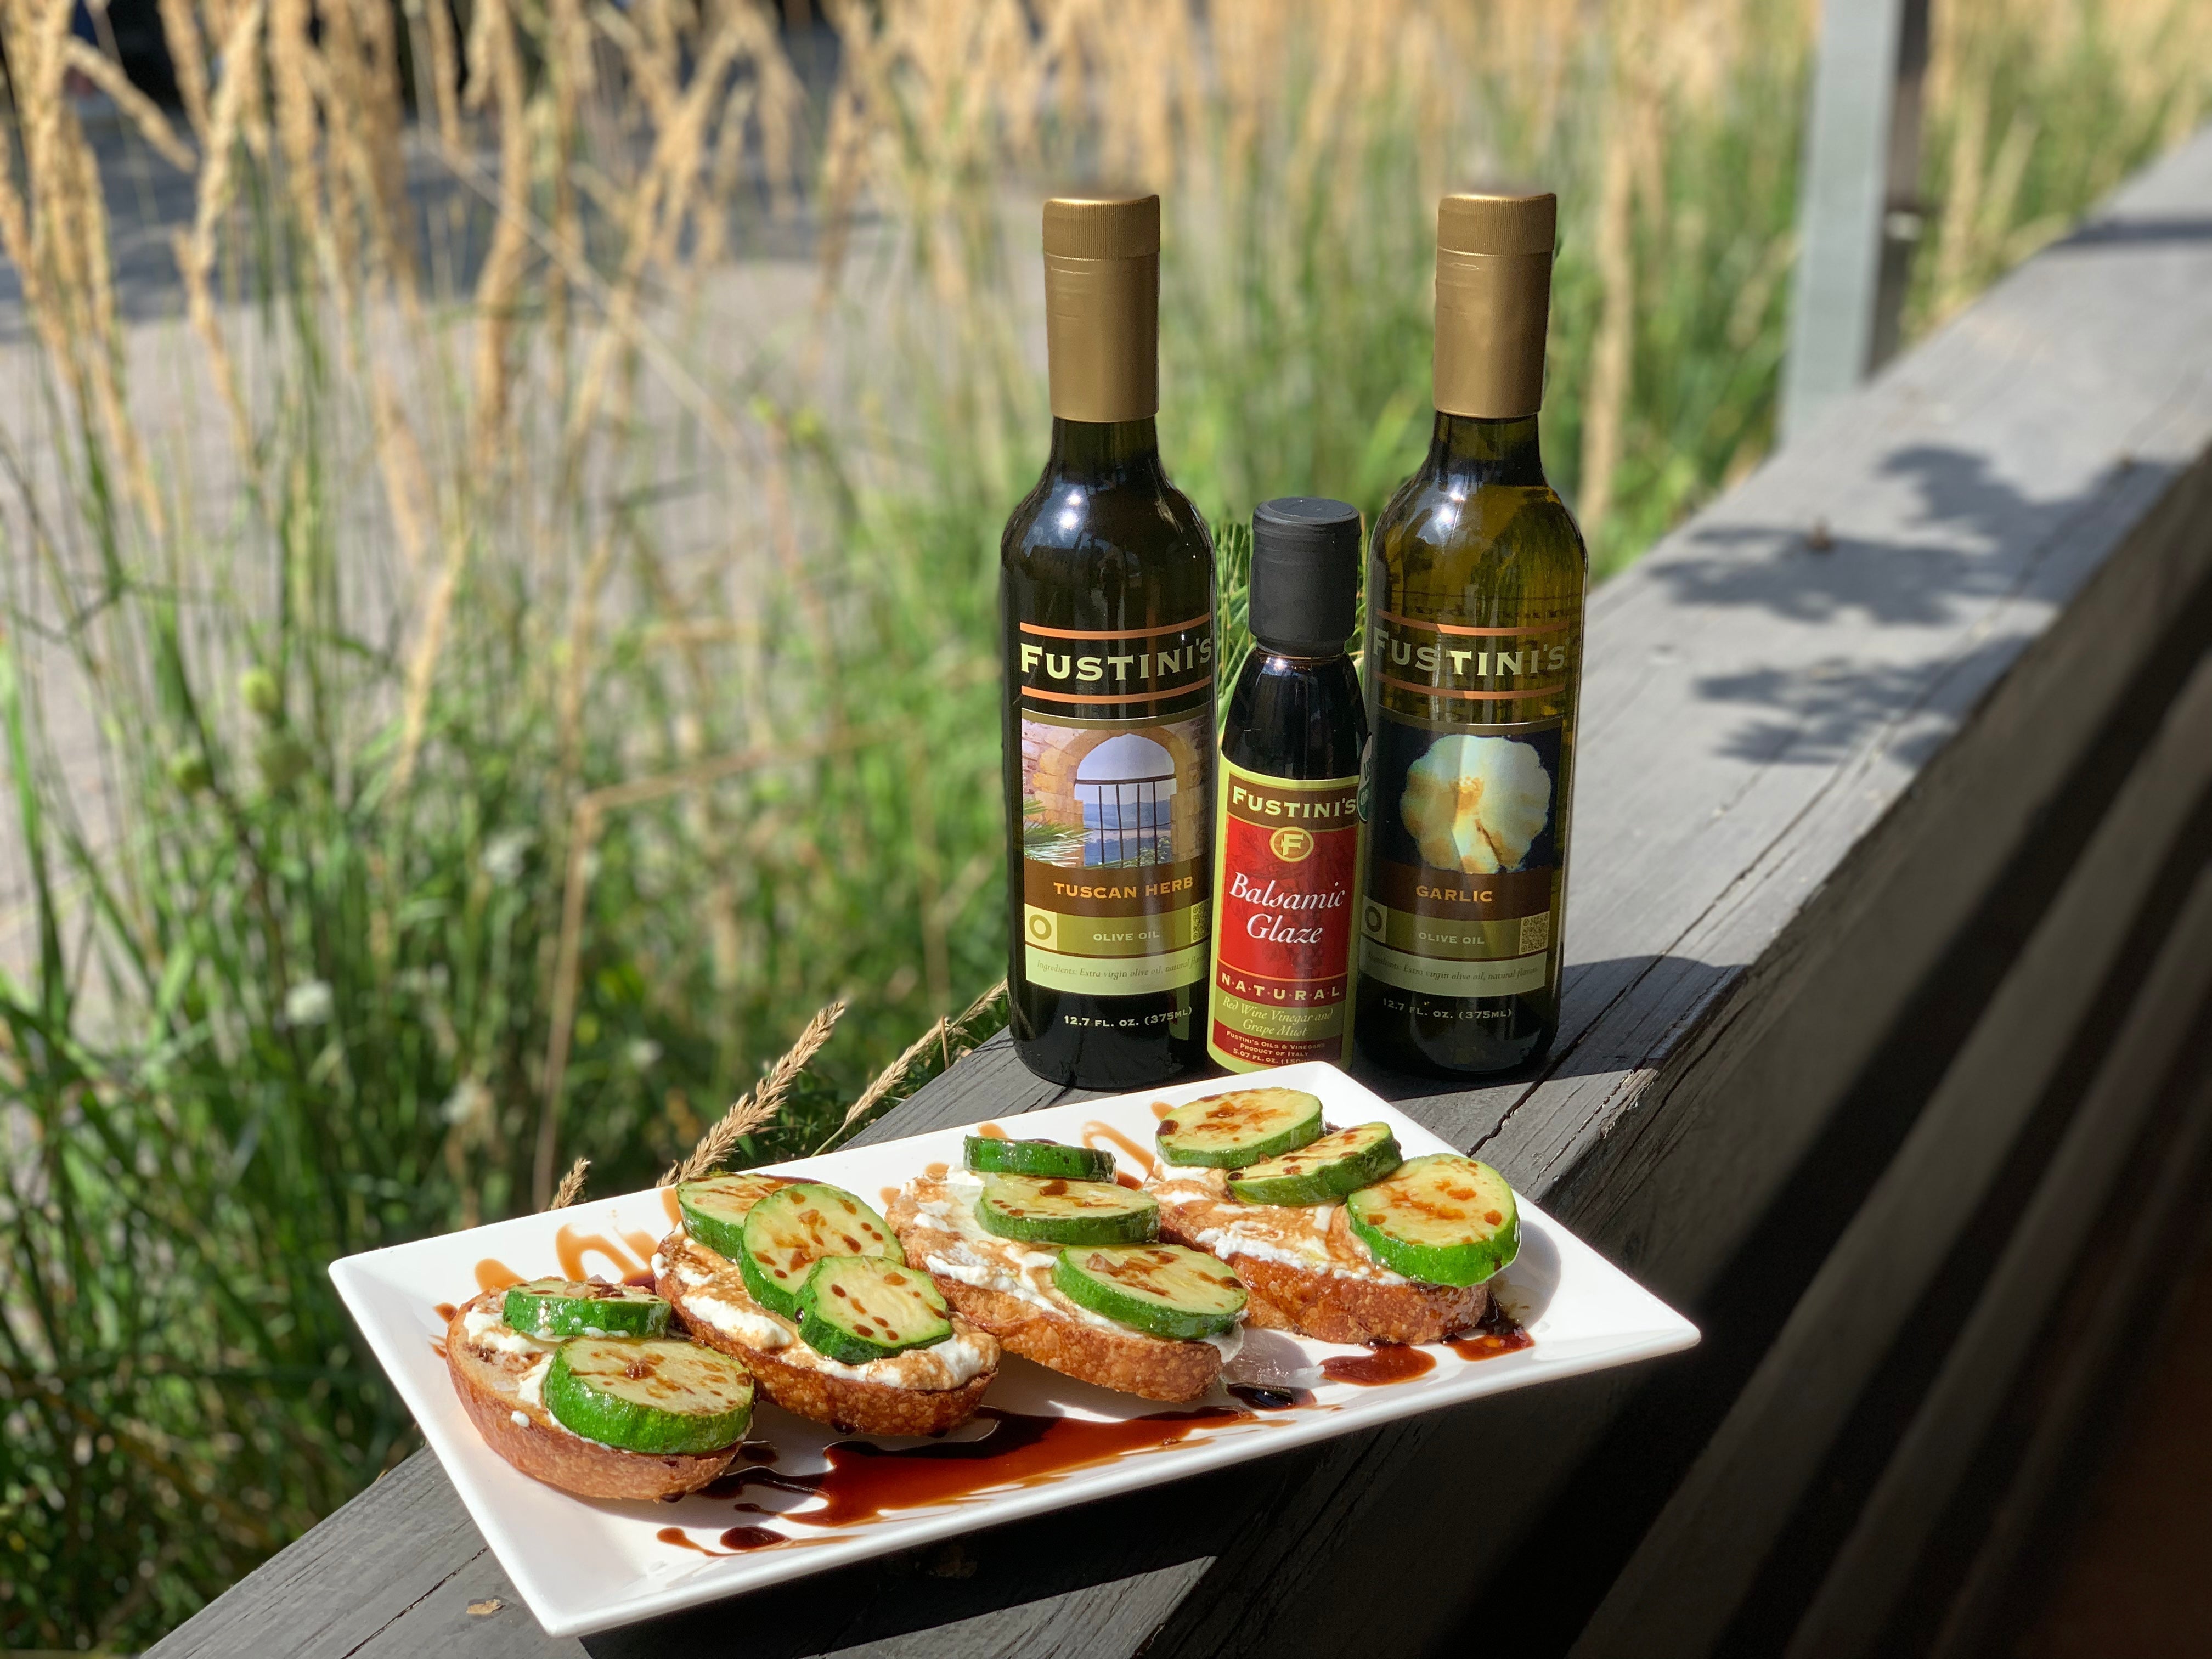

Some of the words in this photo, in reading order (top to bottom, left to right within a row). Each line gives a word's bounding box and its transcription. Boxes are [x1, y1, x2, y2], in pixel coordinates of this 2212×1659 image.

[1020, 638, 1212, 681] FUSTINI'S
[1373, 627, 1565, 676] FUSTINI'S
[1232, 785, 1356, 818] FUSTINI'S
[1280, 833, 1304, 856] F
[1053, 882, 1137, 899] TUSCAN
[1146, 876, 1193, 896] HERB
[1229, 872, 1345, 910] Balsamic
[1416, 885, 1493, 902] GARLIC
[1093, 933, 1133, 941] OLIVE
[1138, 930, 1160, 940] OIL
[1246, 913, 1324, 944] Glaze
[1419, 932, 1457, 944] OLIVE
[1462, 936, 1485, 945] OIL
[1037, 960, 1077, 975] Ingredients:
[1080, 968, 1101, 977] Extra
[1104, 972, 1127, 980] virgin
[1130, 968, 1149, 977] olive
[1151, 966, 1163, 974] oil,
[1165, 958, 1189, 972] natural
[1403, 964, 1423, 975] Extra
[1426, 971, 1449, 980] virgin
[1452, 972, 1470, 980] olive
[1472, 972, 1486, 980] oil,
[1488, 969, 1515, 980] natural
[1064, 1015, 1090, 1026] 12.7
[1119, 1018, 1139, 1027] OZ.
[1144, 1006, 1192, 1026] (375ML)
[1223, 996, 1239, 1010] Red
[1242, 1003, 1268, 1019] Wine
[1271, 1010, 1312, 1026] Vinegar
[1314, 1008, 1334, 1022] and
[1383, 998, 1404, 1011] 12.7
[1409, 1006, 1427, 1015] FL.
[1433, 1011, 1453, 1019] OZ.
[1458, 1008, 1511, 1020] (375ML)
[1226, 1030, 1259, 1046] FUSTINI'S
[1243, 1019, 1274, 1036] Grape
[1276, 1025, 1308, 1036] Must
[1233, 1048, 1250, 1058] 5.07
[1240, 1043, 1273, 1055] PRODUCT
